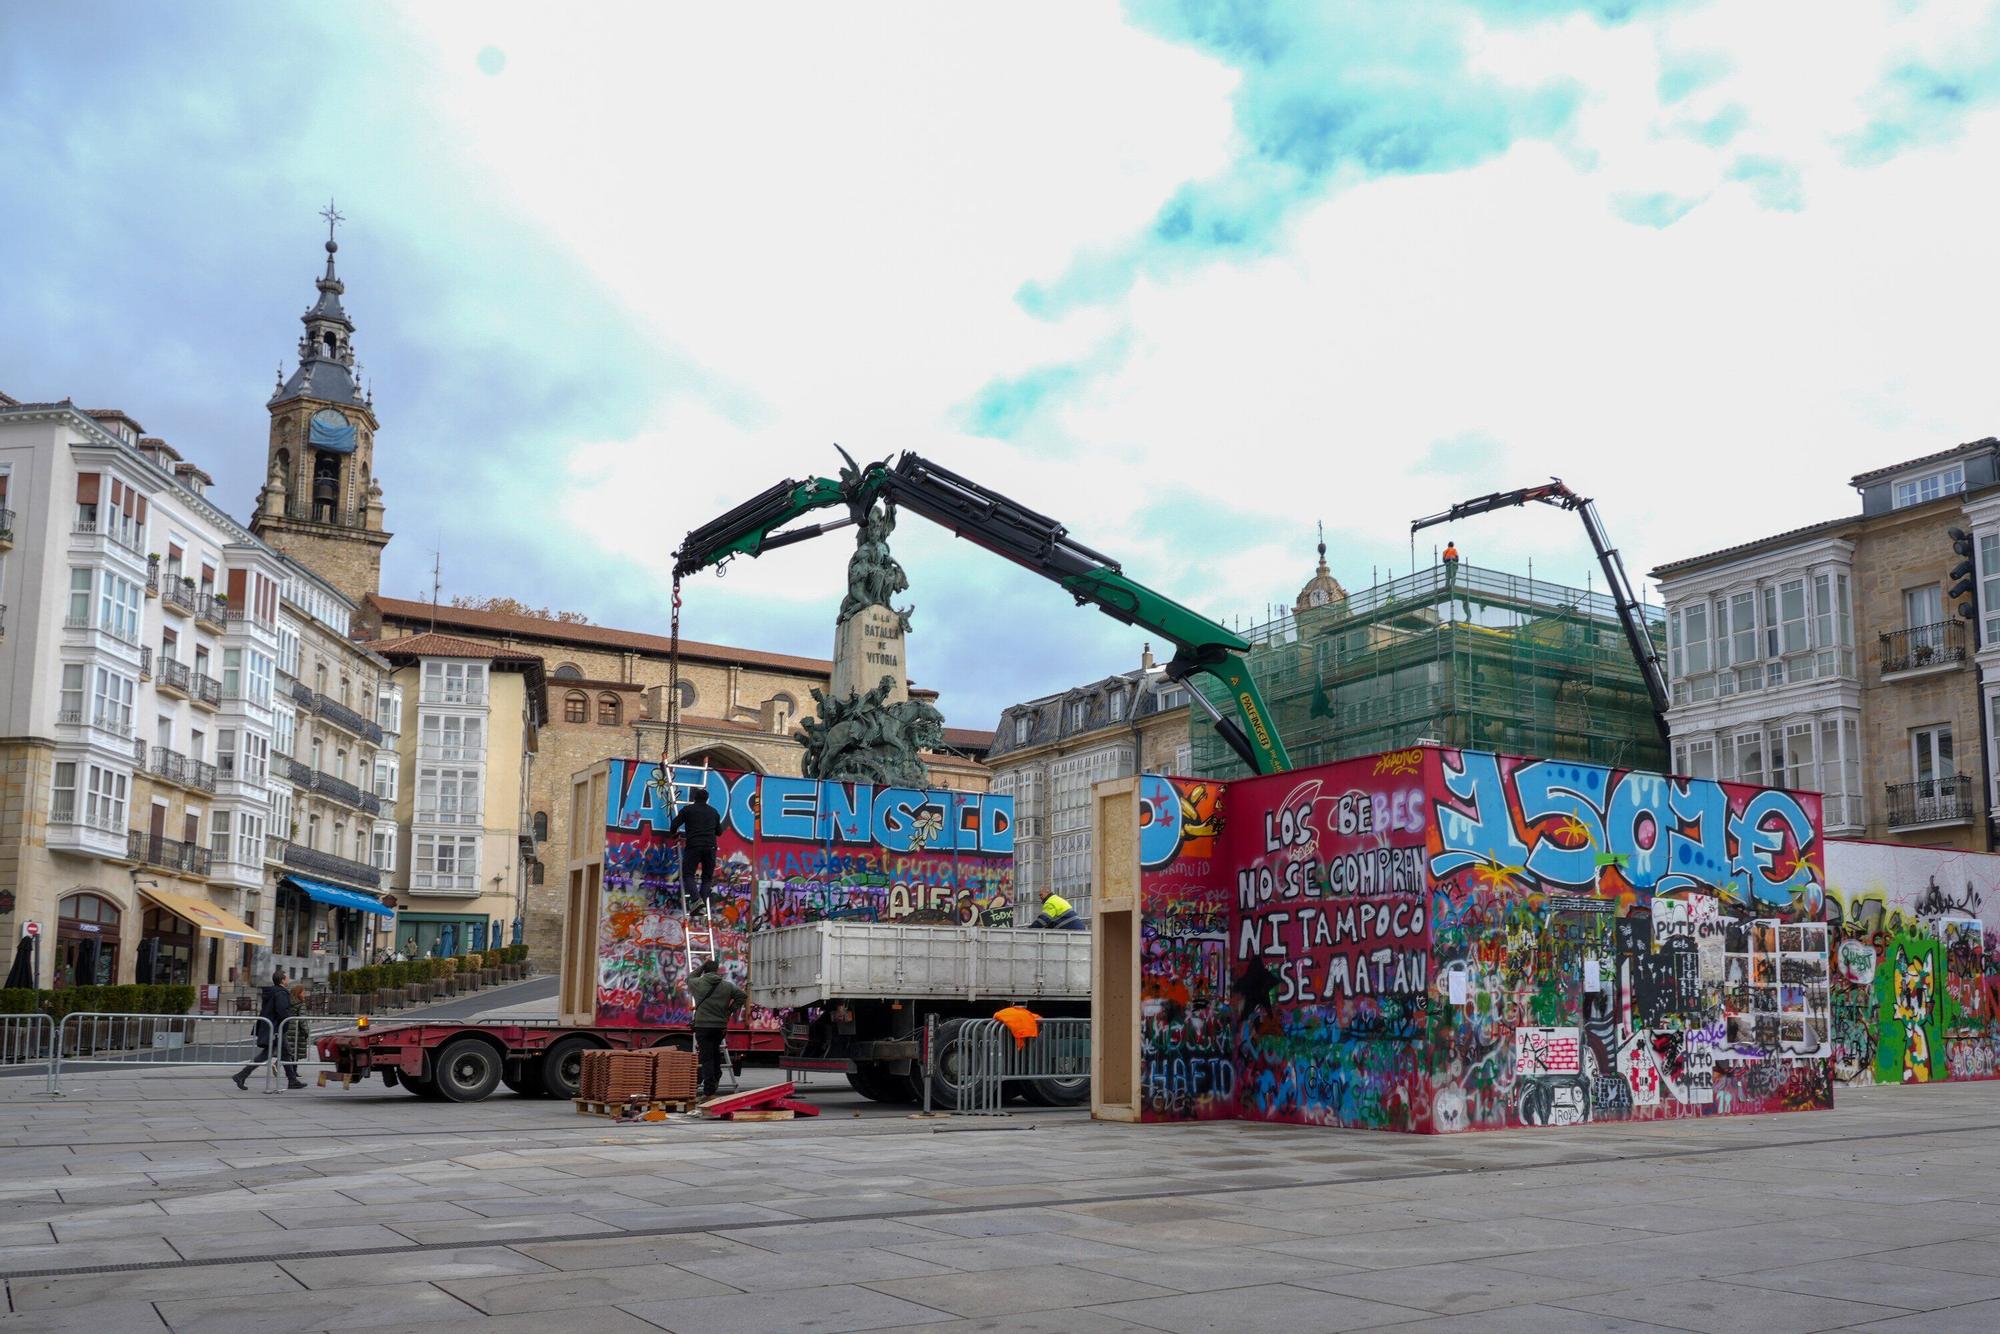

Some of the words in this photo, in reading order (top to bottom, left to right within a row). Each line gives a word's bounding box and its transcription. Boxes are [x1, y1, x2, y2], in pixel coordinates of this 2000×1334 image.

[864, 625, 899, 640] BATALLA
[866, 651, 898, 667] VITORIA
[878, 641, 886, 650] DE
[1241, 694, 1269, 747] PALFINGER
[1265, 802, 1312, 855] LOS
[1337, 789, 1425, 836] BEBES
[1238, 867, 1274, 910] NO
[1284, 859, 1321, 899] SE
[1329, 845, 1427, 896] COMPRAN
[1238, 911, 1289, 960] NI
[1298, 901, 1426, 949] TAMPOCO
[1656, 921, 1696, 941] PUTO
[1278, 956, 1316, 1002] SE
[1322, 948, 1427, 998] MATAN
